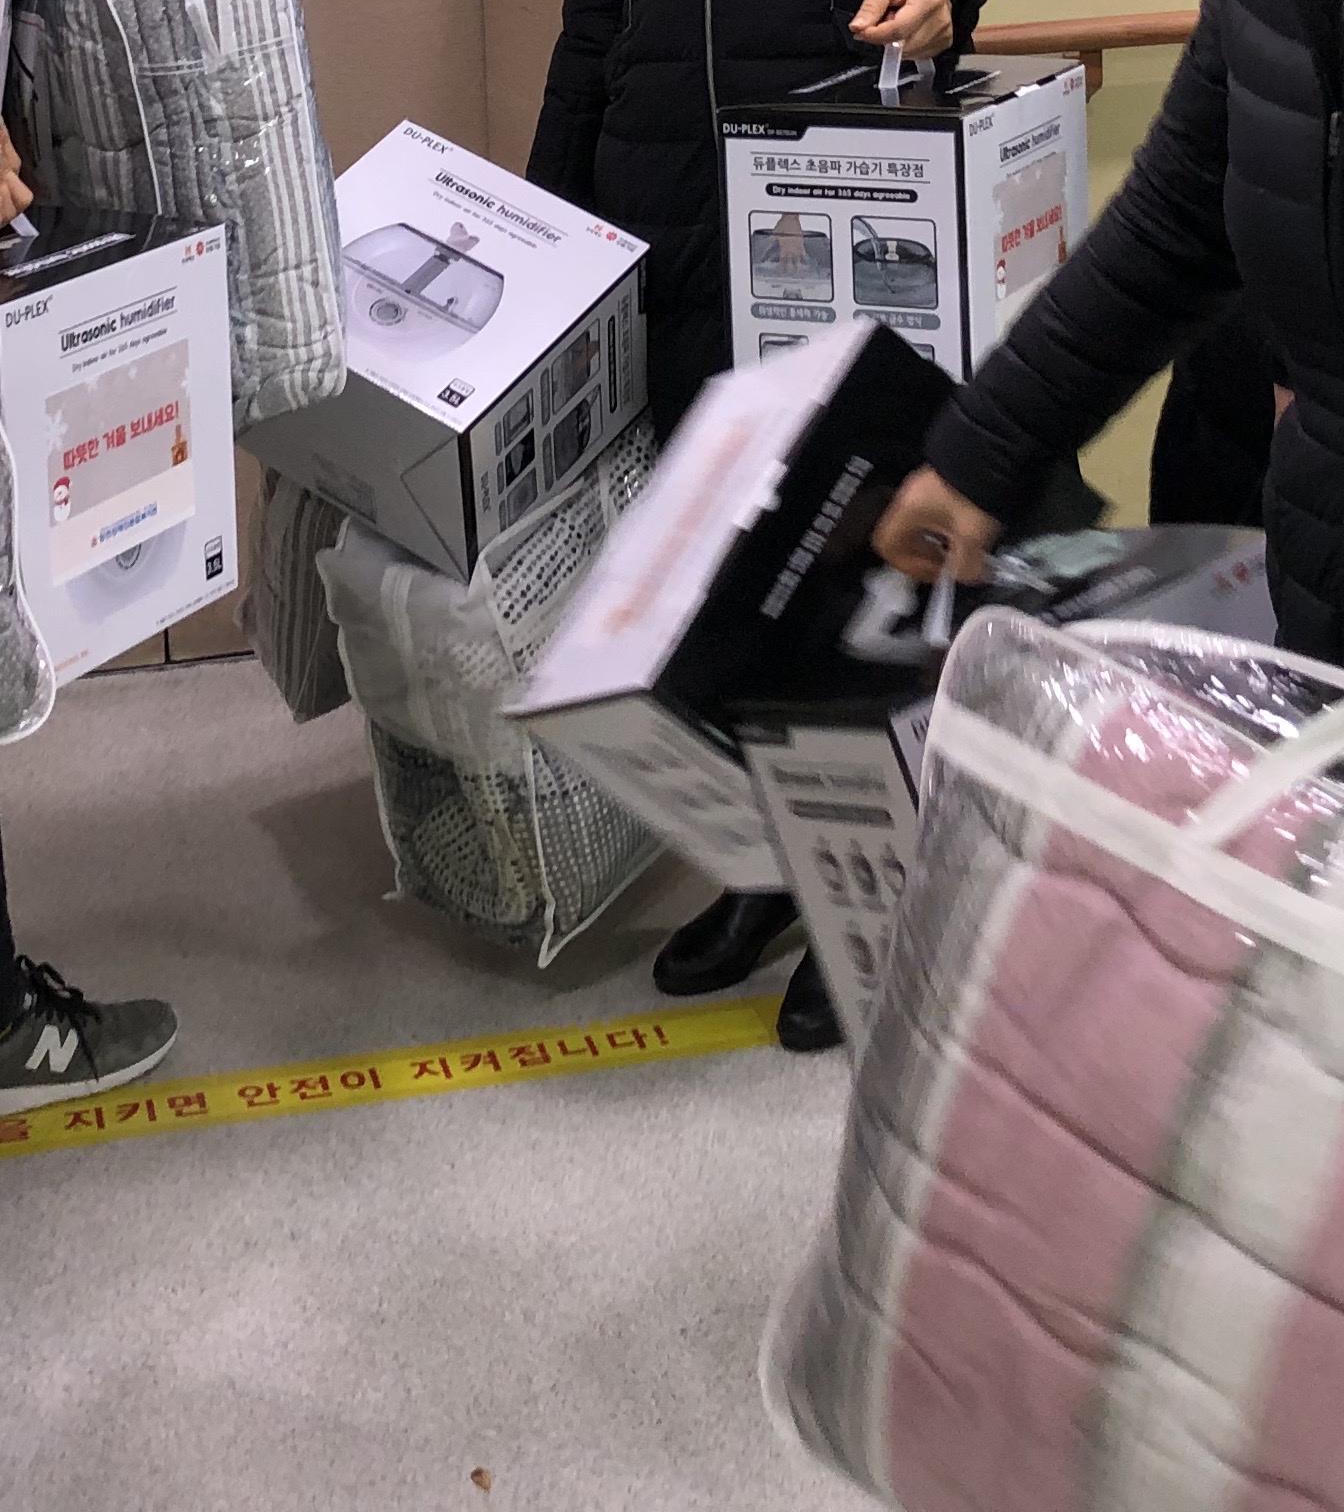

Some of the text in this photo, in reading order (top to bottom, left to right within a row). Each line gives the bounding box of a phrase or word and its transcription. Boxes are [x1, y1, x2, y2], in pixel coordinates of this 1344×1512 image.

[403, 127, 448, 154] DU-PLEX
[722, 122, 765, 135] DU-PLEX
[753, 156, 924, 178] 듀플렉스 초음파 가습기 특장점
[435, 171, 495, 209] Ultrasonic
[497, 204, 561, 243] humidifier
[6, 300, 49, 328] DU-PLEX
[60, 295, 175, 352] Ultrasonic humidifier
[63, 400, 179, 471] 따뜻한 겨울 보내세요!
[25, 1024, 79, 1073] N
[63, 1091, 209, 1134] 지키면
[236, 1066, 382, 1109] 안전이
[410, 1024, 671, 1083] 지켜집니다!
